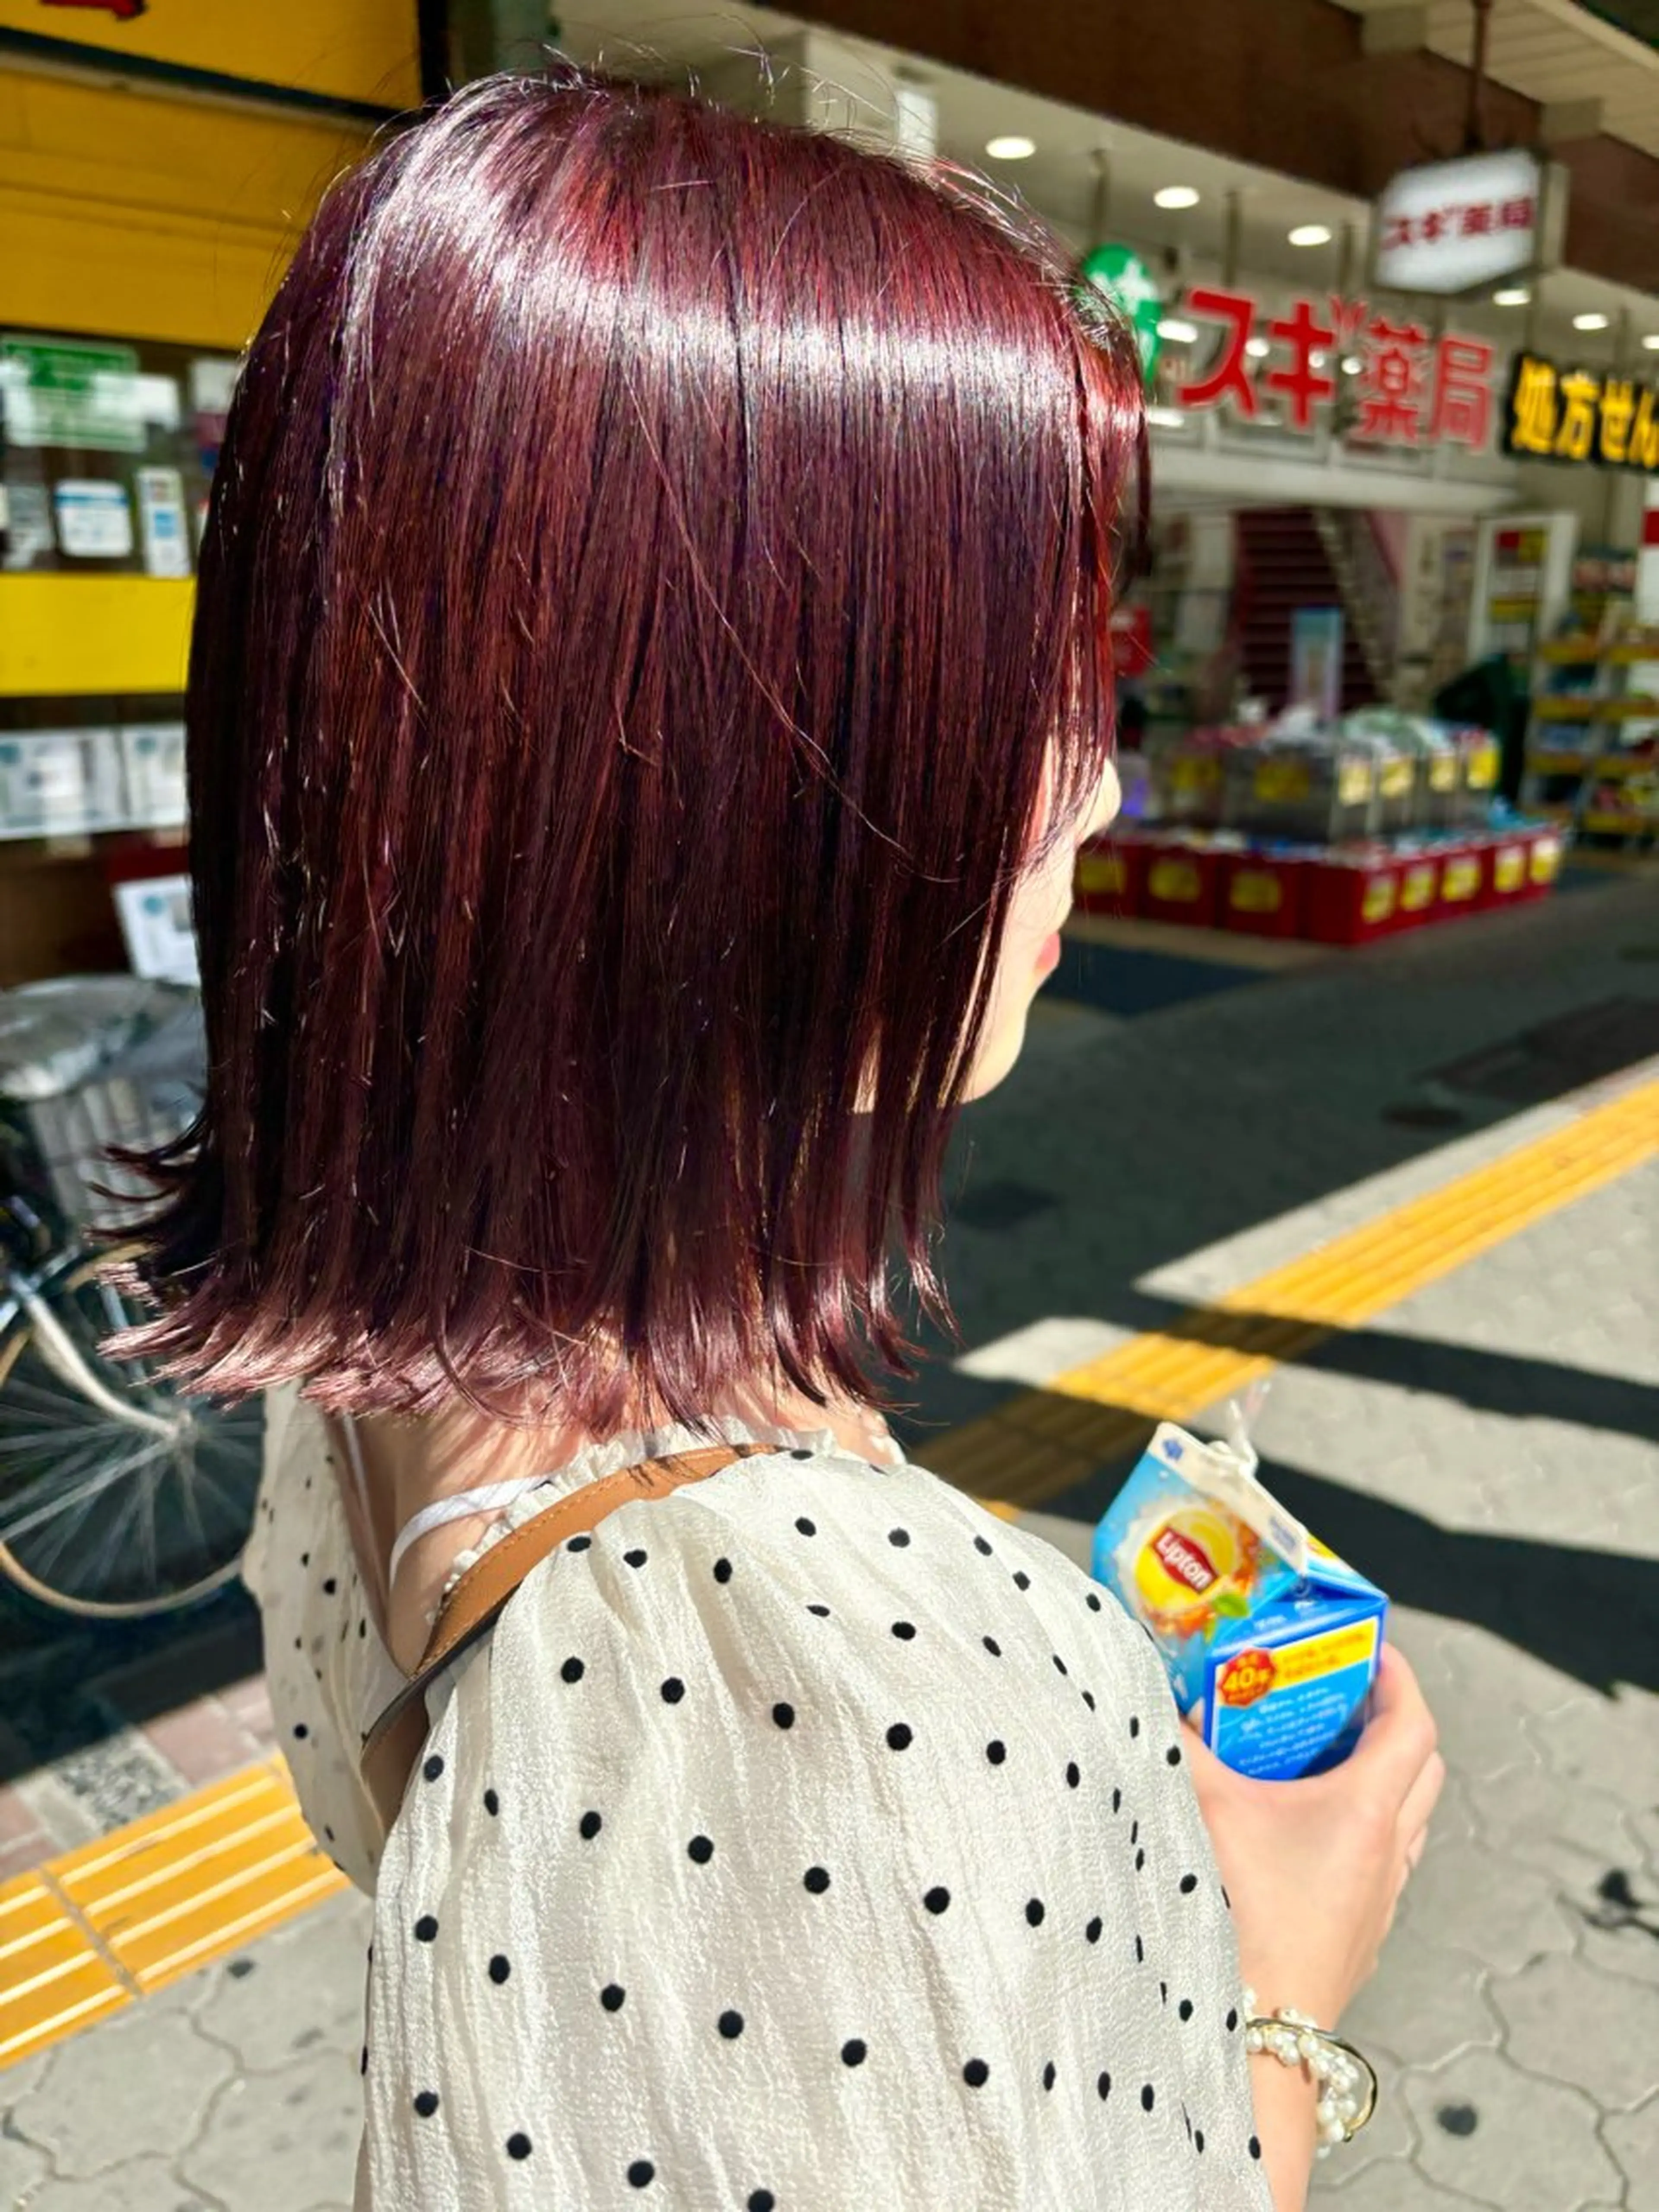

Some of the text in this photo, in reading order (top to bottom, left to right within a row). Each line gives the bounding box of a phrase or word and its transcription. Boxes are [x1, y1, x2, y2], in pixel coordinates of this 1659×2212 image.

[1177, 289, 1492, 451] スギ薬局
[1156, 1532, 1212, 1589] Lipton
